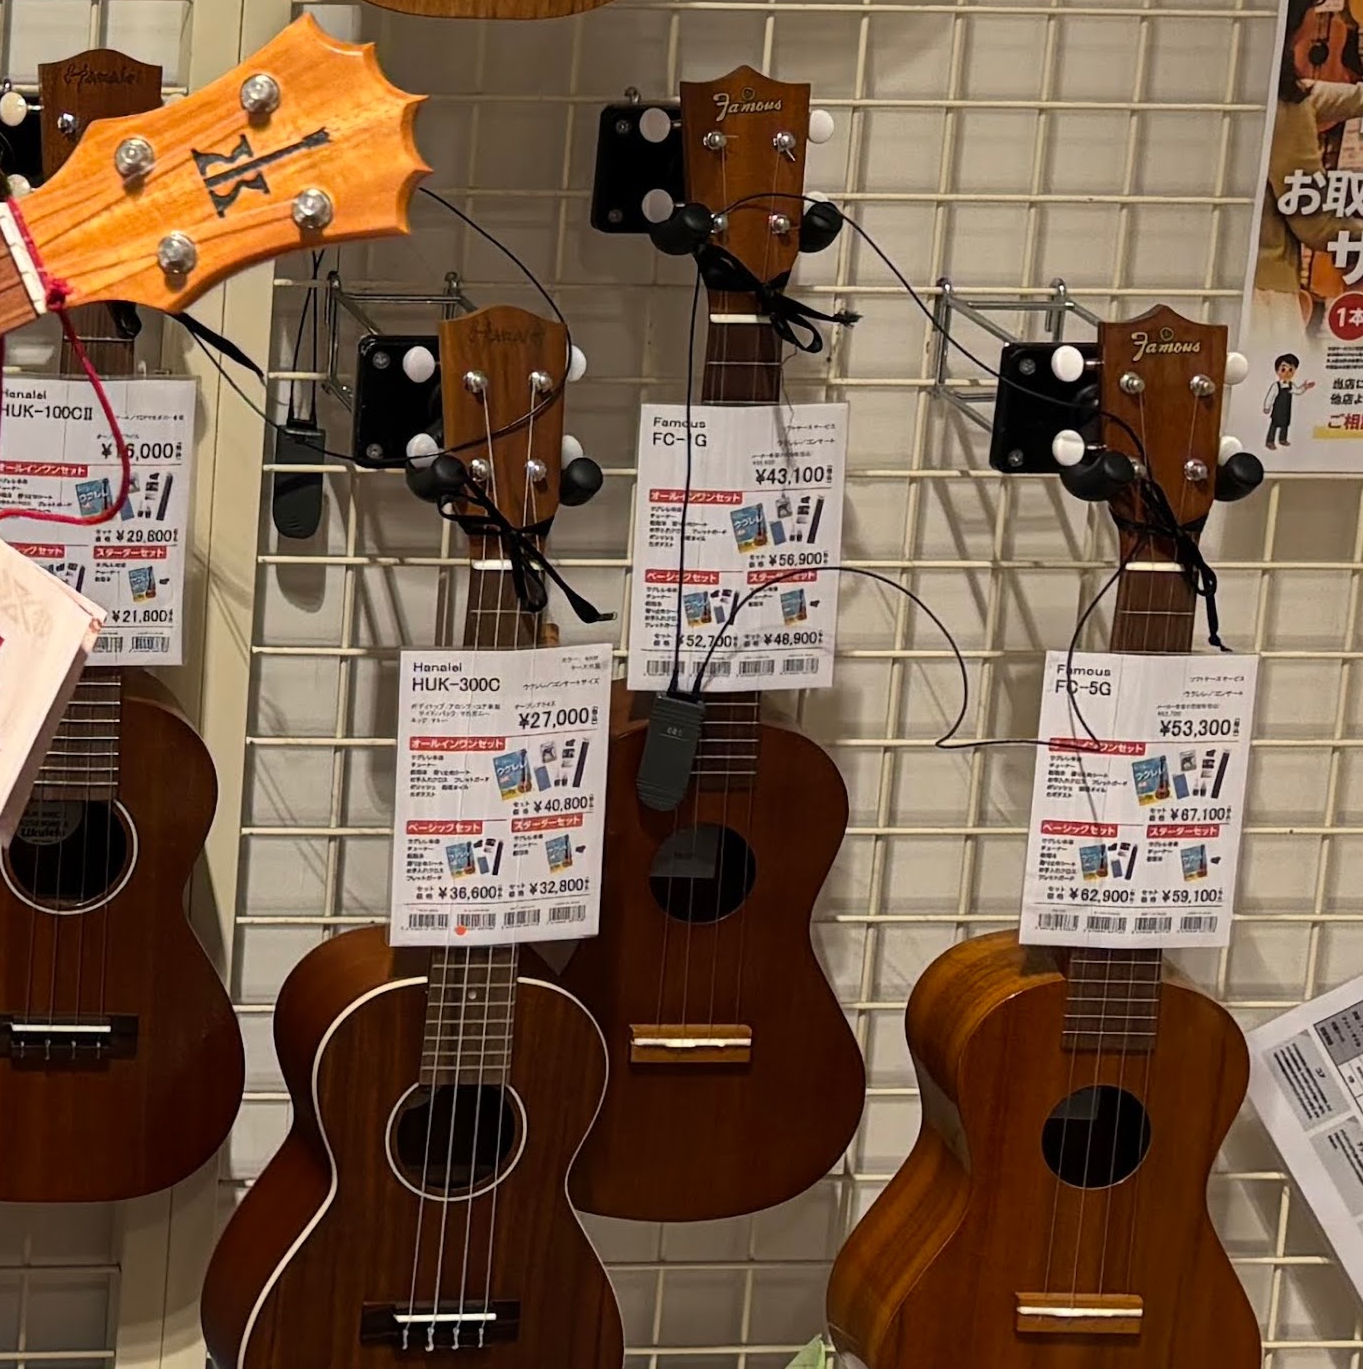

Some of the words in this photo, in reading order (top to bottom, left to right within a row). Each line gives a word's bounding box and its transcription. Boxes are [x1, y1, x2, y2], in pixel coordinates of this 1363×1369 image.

[713, 92, 783, 122] Famous
[1131, 331, 1201, 362] Famous
[652, 432, 707, 447] FC-G
[756, 466, 824, 486] ¥43,100
[412, 677, 501, 692] HUK-300C
[1055, 680, 1112, 697] FC-5G
[518, 707, 589, 730] ¥27,000
[1159, 719, 1231, 739] ¥53,300
